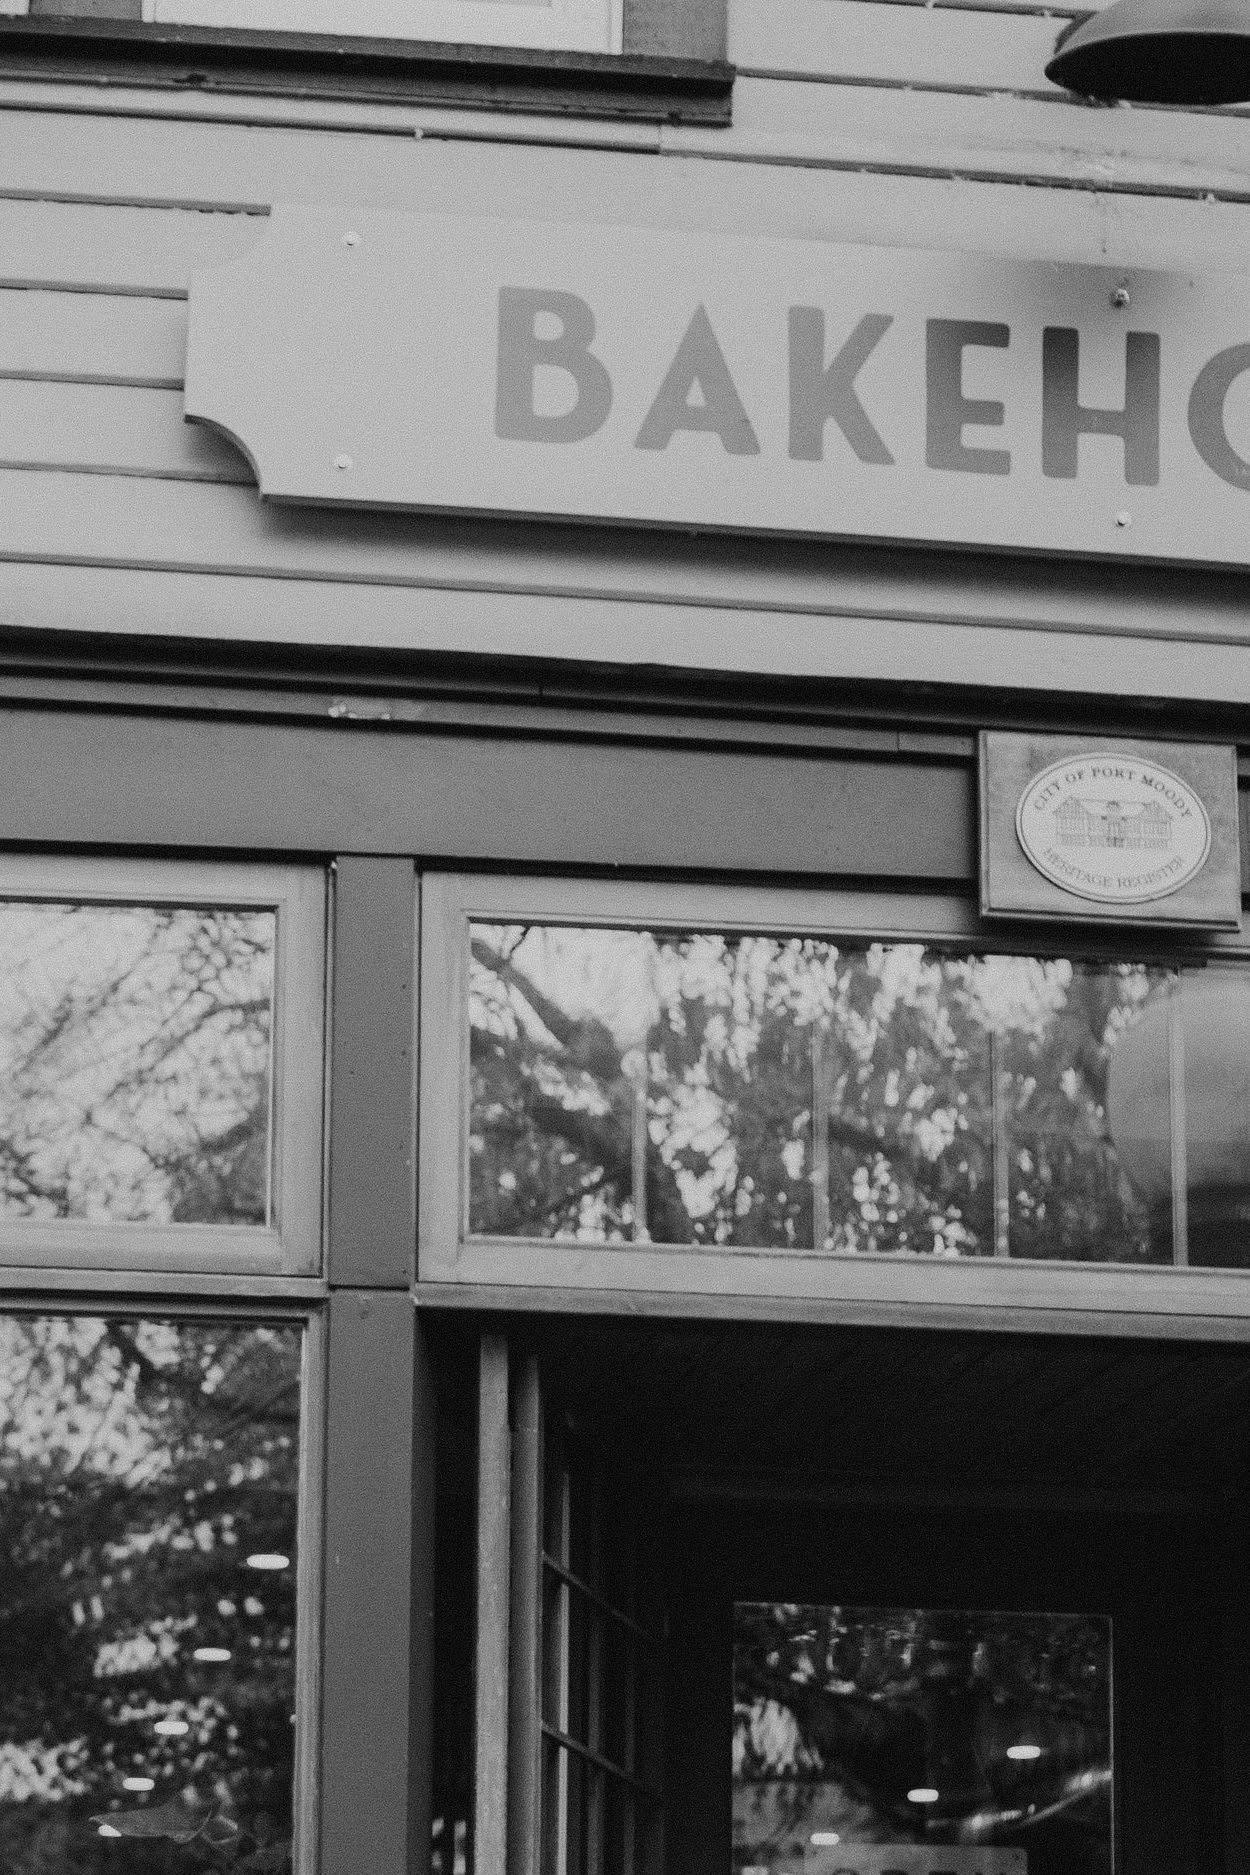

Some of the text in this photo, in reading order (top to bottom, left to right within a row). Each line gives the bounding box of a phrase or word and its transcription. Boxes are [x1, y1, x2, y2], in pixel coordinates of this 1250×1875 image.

[1034, 766, 1193, 818] CITY OF PORT MOODY
[1043, 848, 1184, 888] HERITAGE REGISTER
